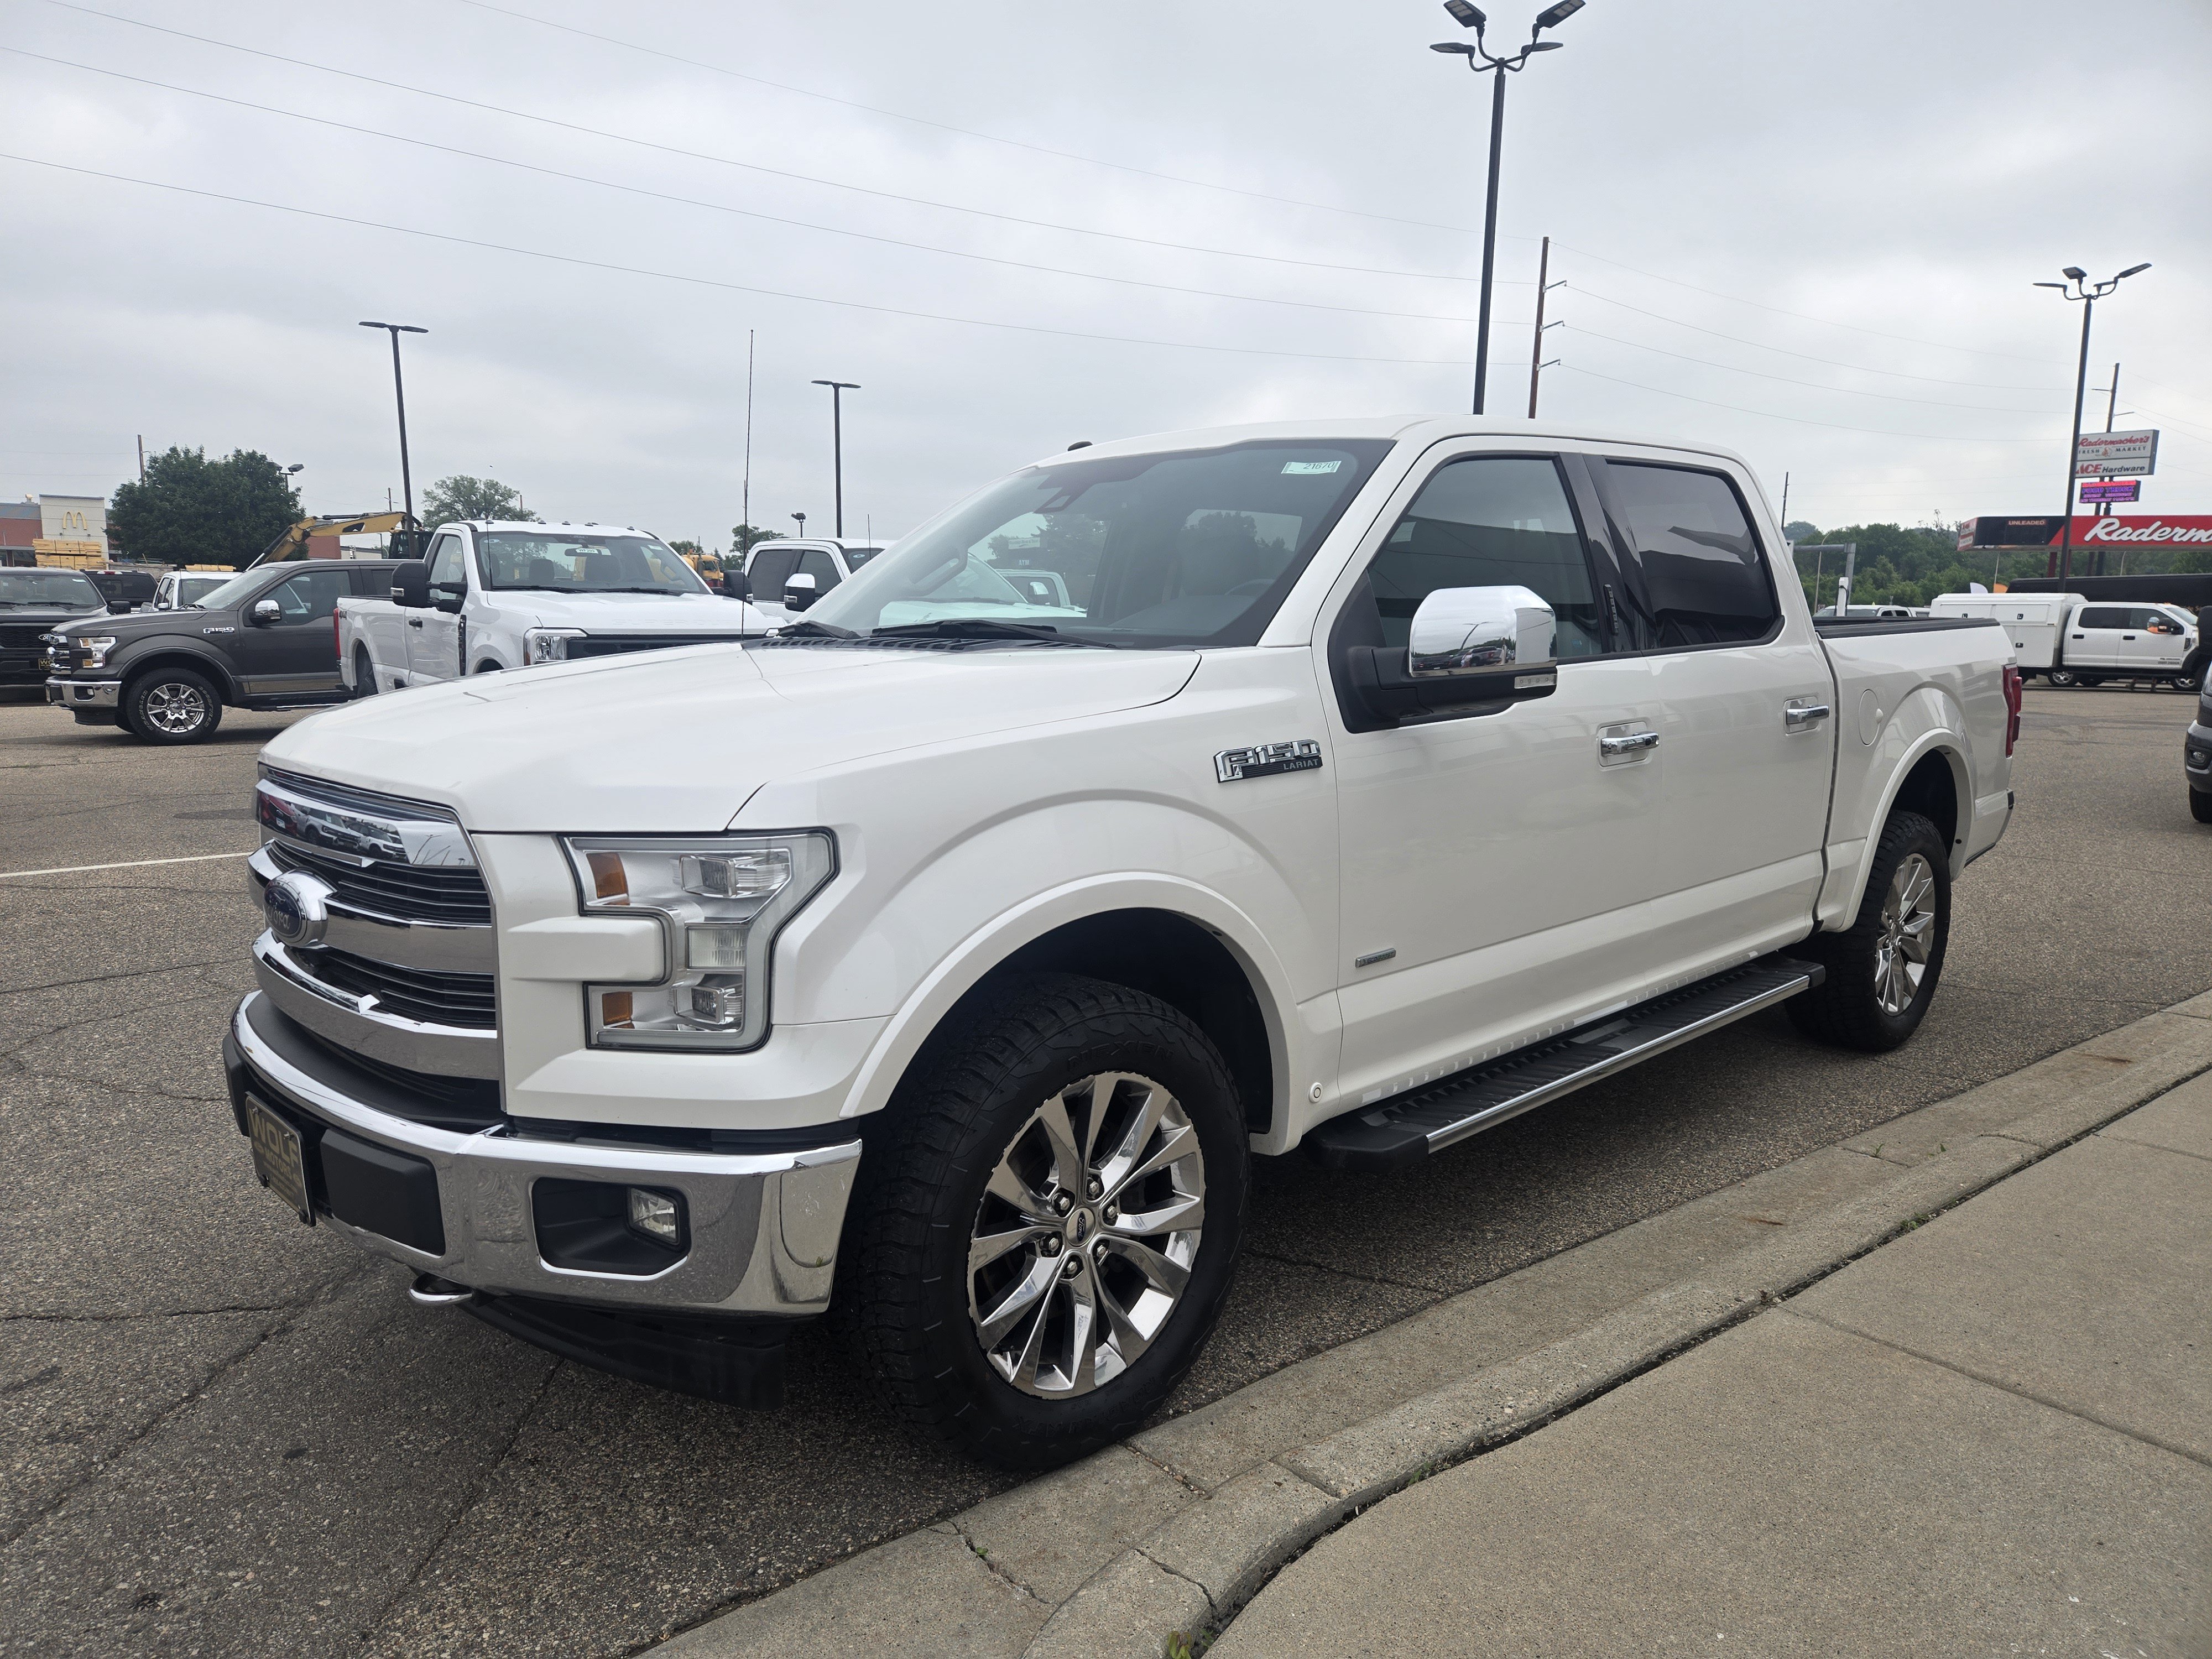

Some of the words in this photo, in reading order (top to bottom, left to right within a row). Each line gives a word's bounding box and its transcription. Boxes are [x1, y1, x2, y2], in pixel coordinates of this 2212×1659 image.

[2079, 436, 2150, 447] Radermacher's
[2075, 463, 2103, 474] ACE
[2084, 518, 2212, 542] Raderm
[1283, 759, 1318, 770] LARIAT
[1067, 1041, 1175, 1071] NEXEN
[249, 1108, 299, 1168] WOLF
[264, 1149, 293, 1180] MOTORS
